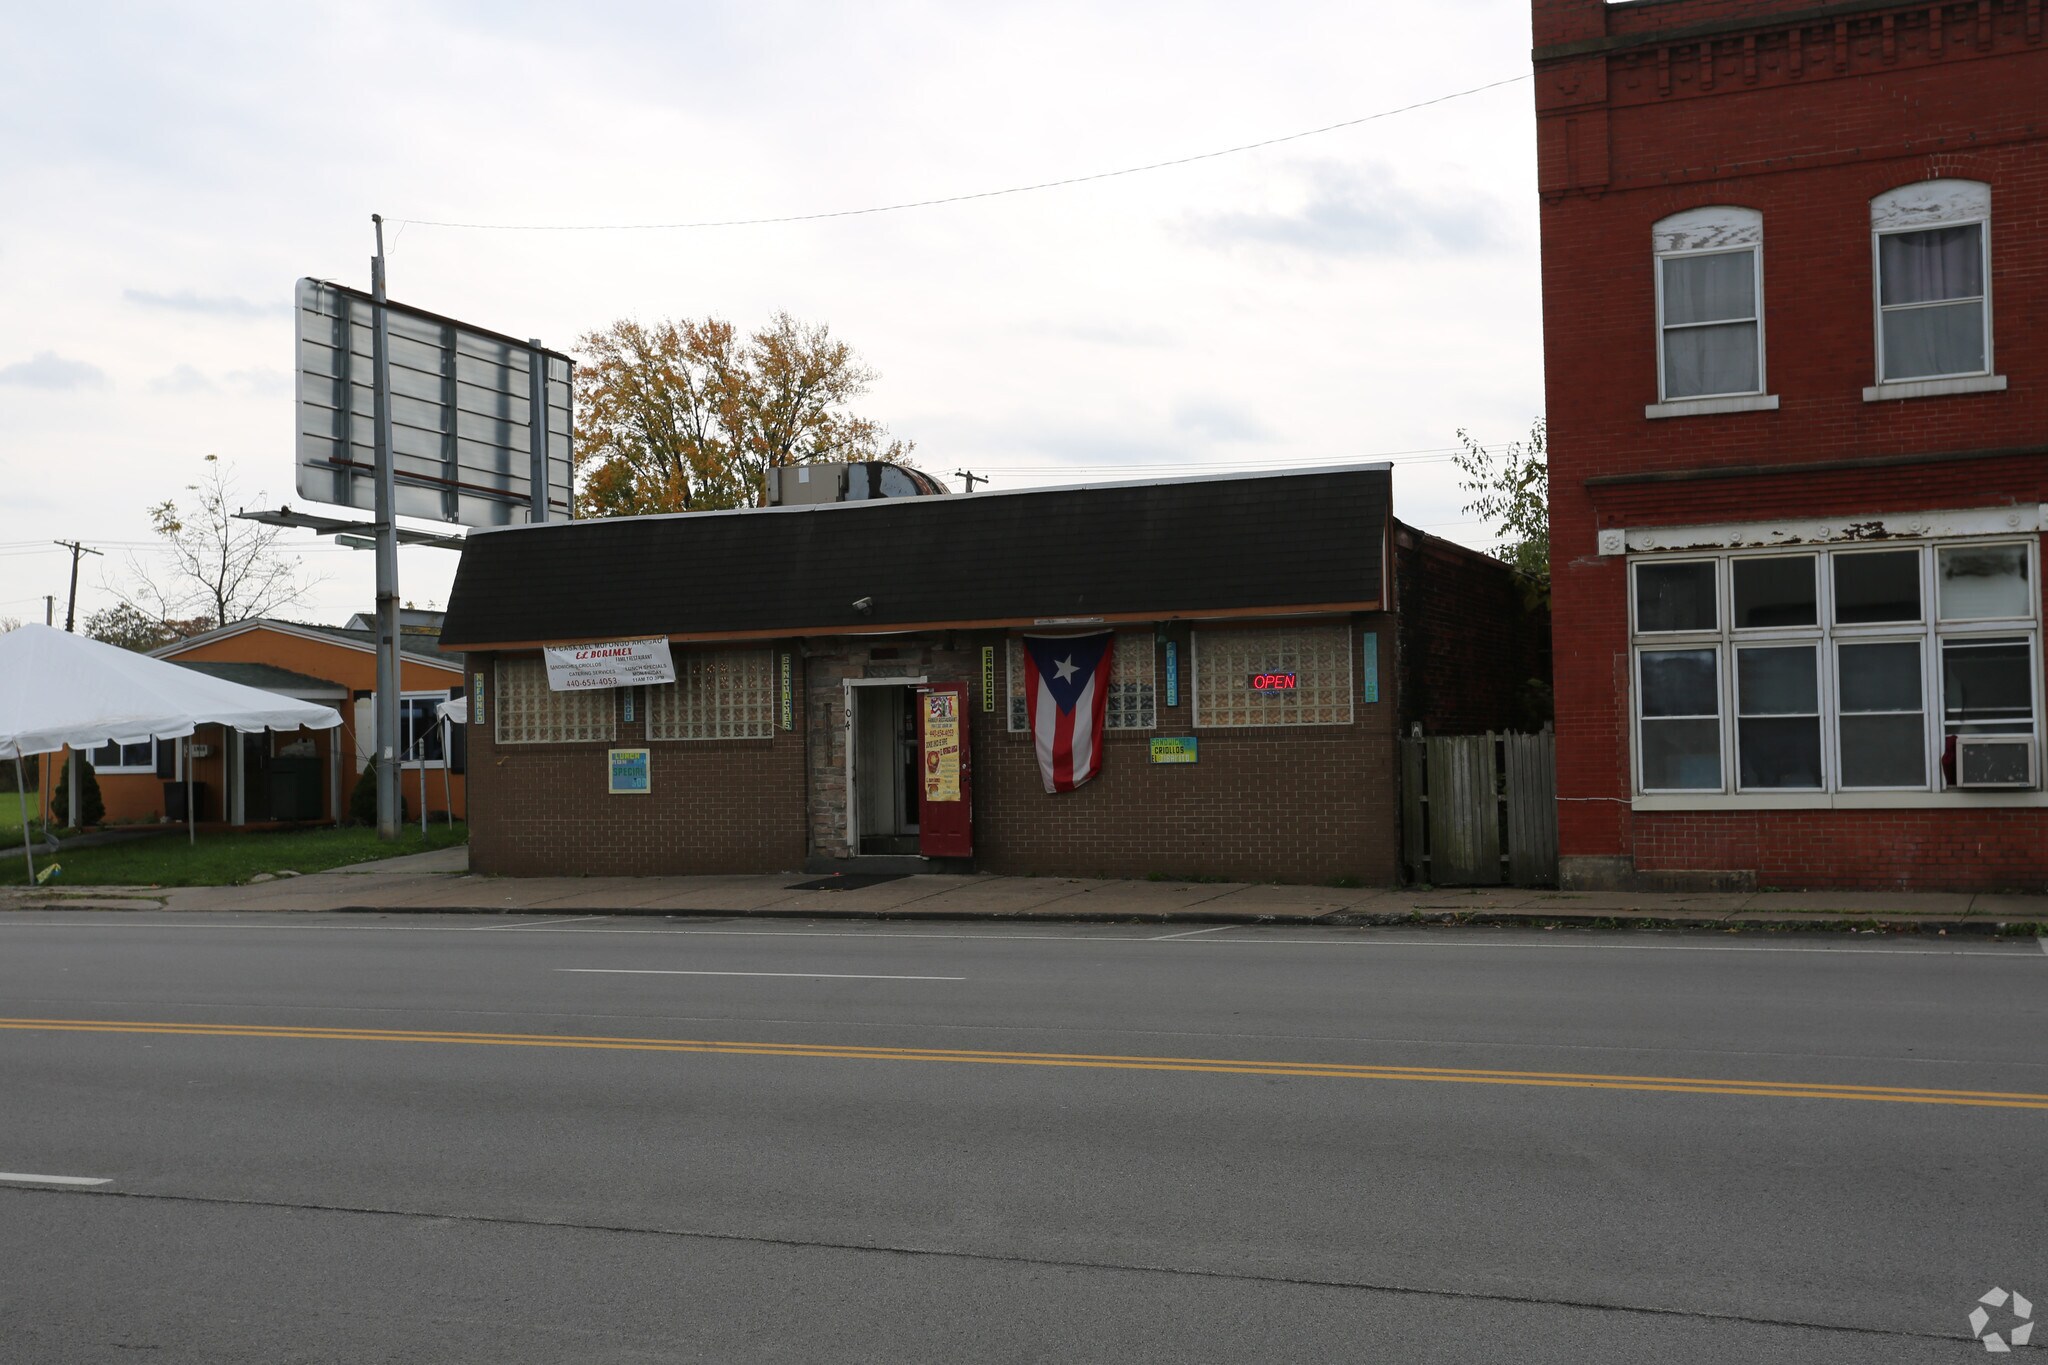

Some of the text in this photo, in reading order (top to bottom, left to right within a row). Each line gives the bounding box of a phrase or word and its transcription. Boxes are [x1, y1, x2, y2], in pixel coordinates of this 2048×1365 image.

[591, 648, 633, 658] BORIMEX
[1167, 642, 1175, 706] FRITURAS
[566, 677, 618, 687] 440-654-4053
[985, 650, 993, 710] SANCOCHO
[1254, 675, 1295, 689] OPEN
[1154, 746, 1184, 754] CRIOLLOS
[1151, 754, 1157, 762] EL
[613, 767, 645, 777] SPECIAL
